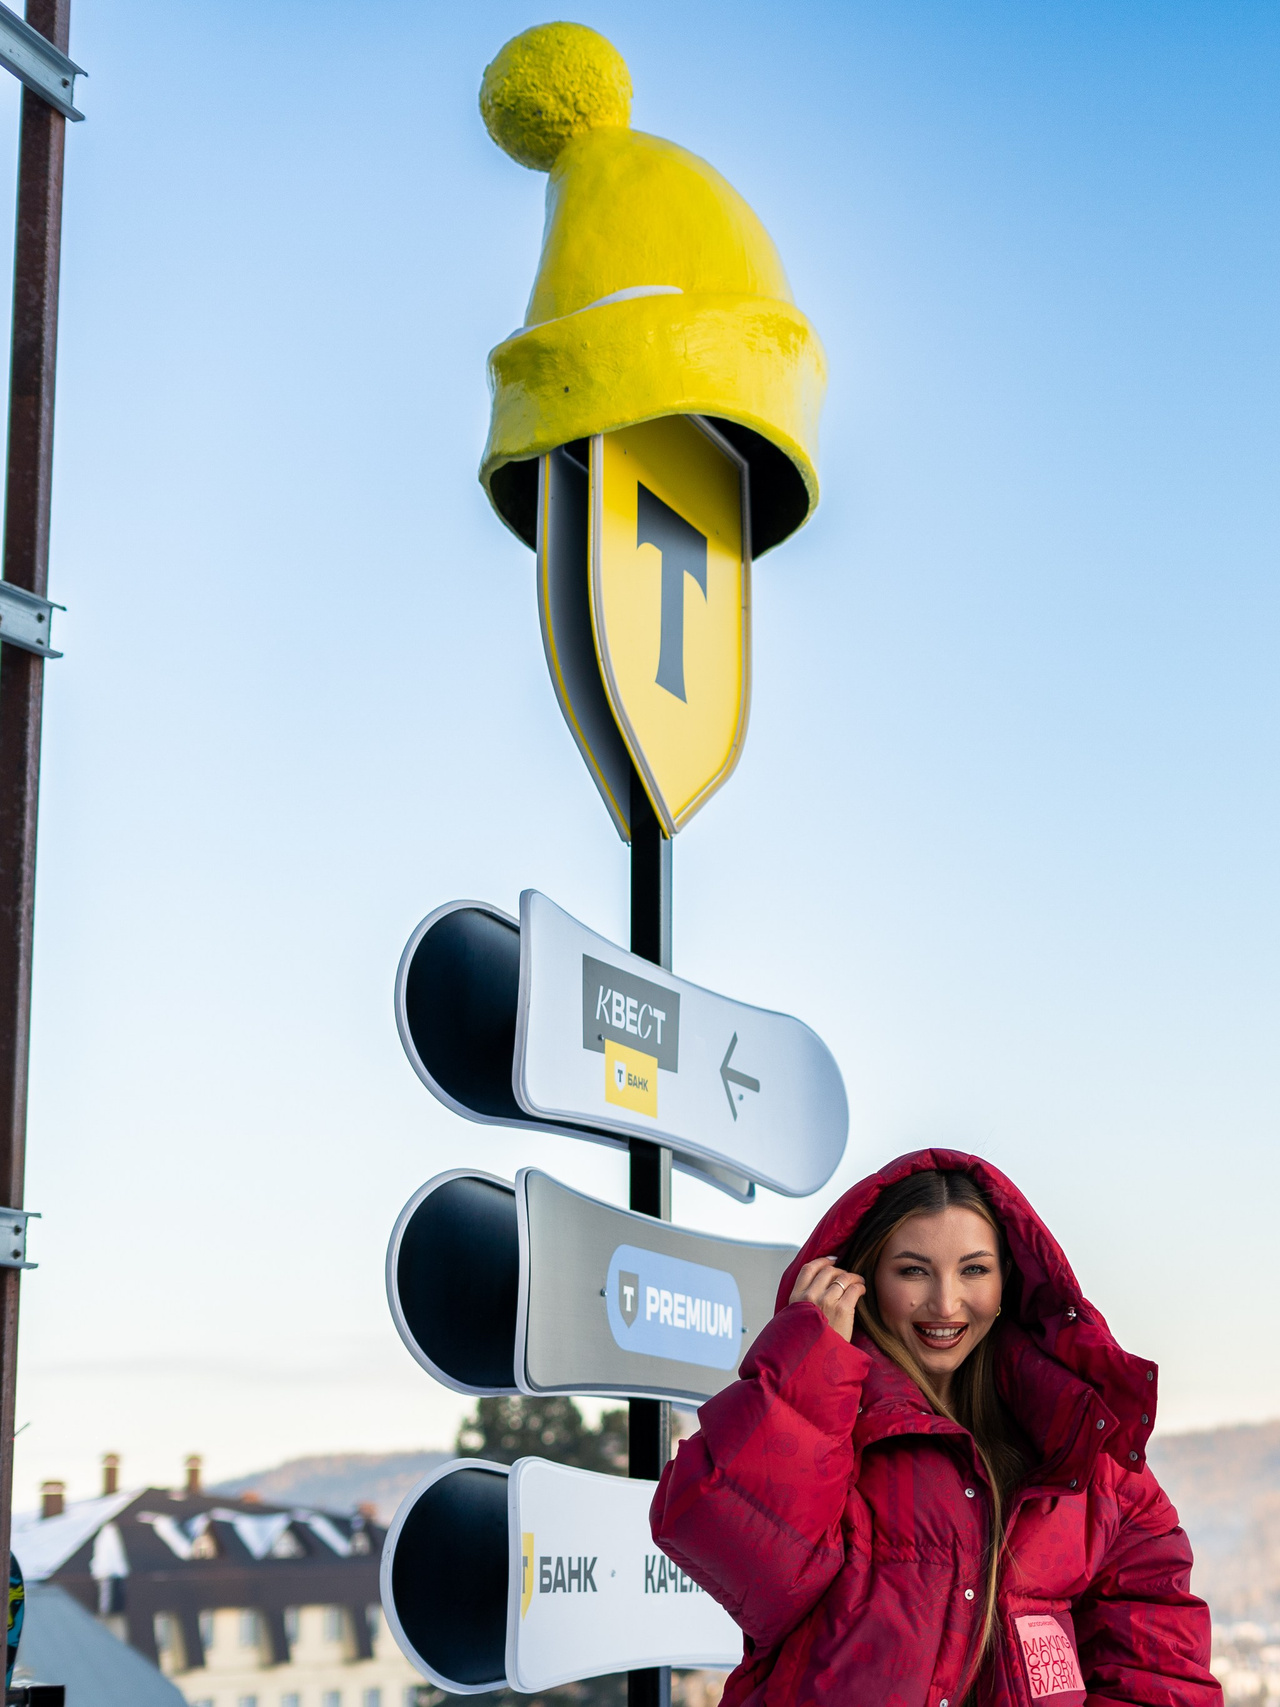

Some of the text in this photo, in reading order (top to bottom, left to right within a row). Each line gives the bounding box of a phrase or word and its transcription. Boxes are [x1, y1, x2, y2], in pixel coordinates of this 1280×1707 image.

[636, 480, 708, 704] Т
[595, 985, 666, 1045] КВЕСТ
[617, 1068, 649, 1092] Т БАНК
[623, 1285, 733, 1339] T PREMIUM
[539, 1556, 598, 1594] БАНК
[644, 1554, 705, 1594] КАЧЕ
[1023, 1635, 1071, 1655] MAKING
[1027, 1648, 1066, 1668] COLD
[1031, 1660, 1074, 1682] STORY
[1032, 1675, 1078, 1695] WARM
